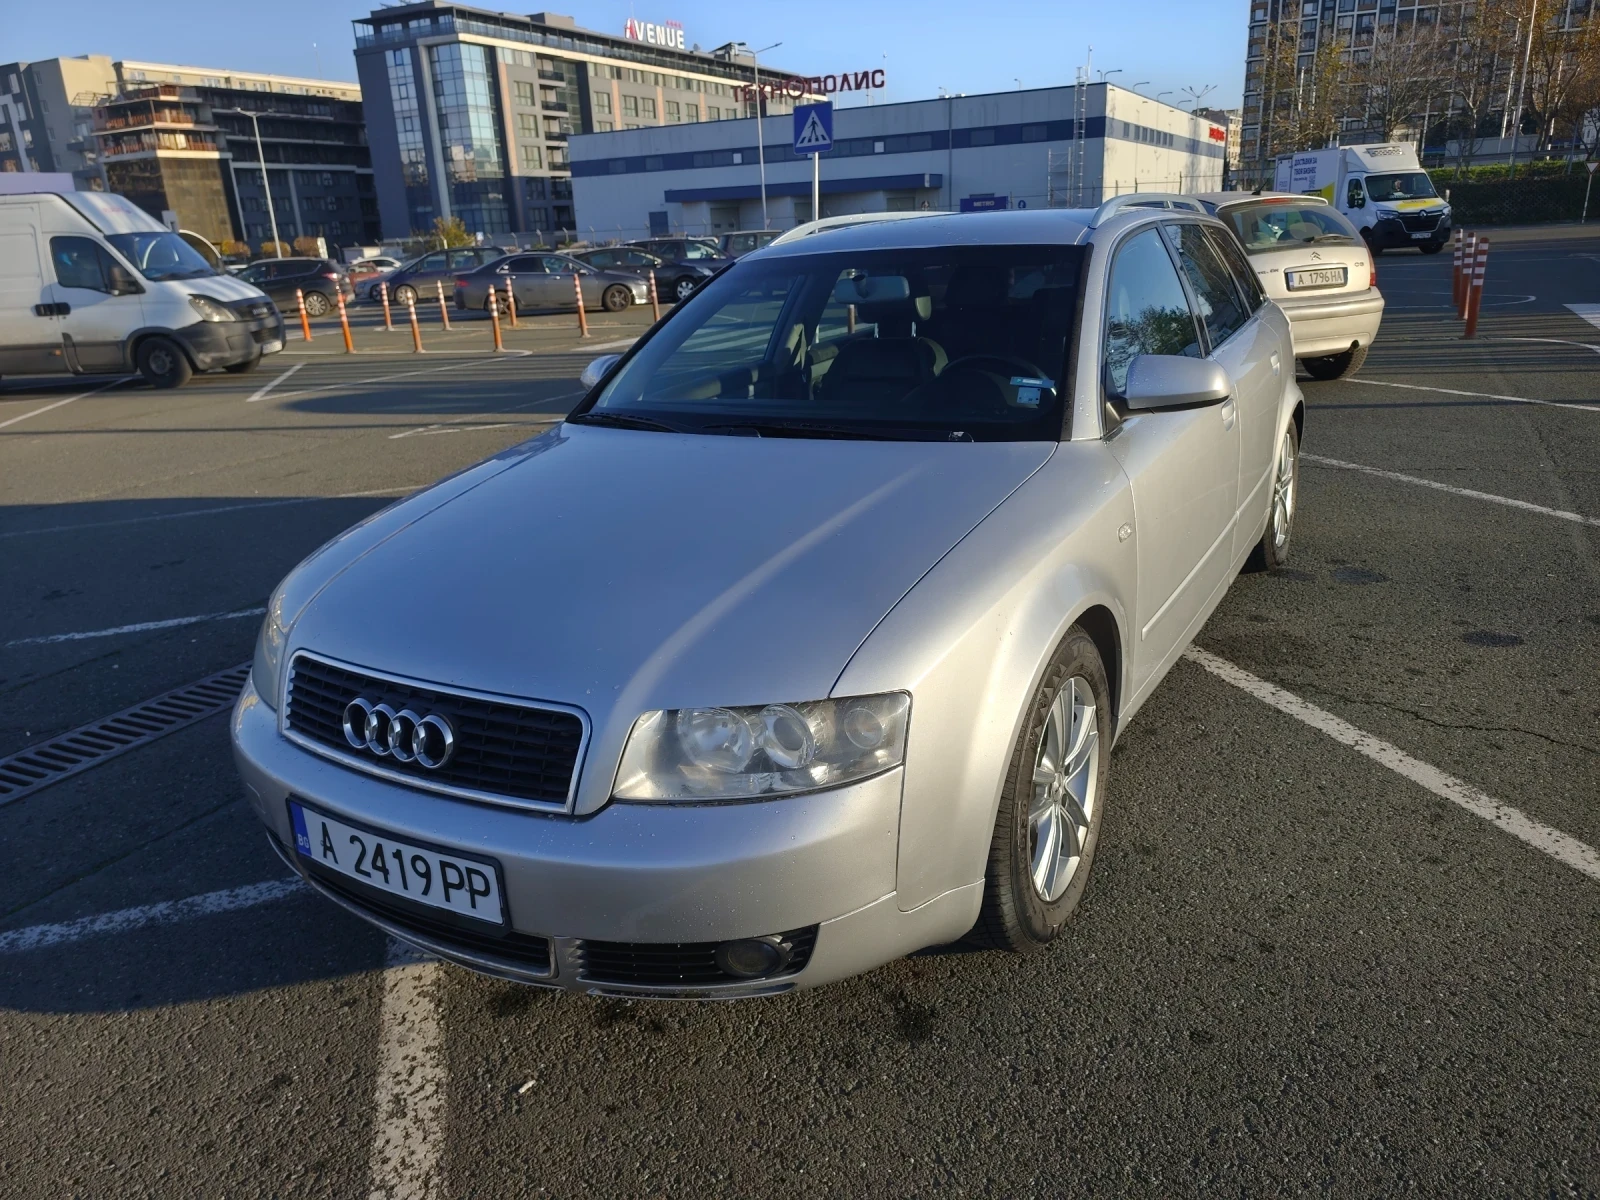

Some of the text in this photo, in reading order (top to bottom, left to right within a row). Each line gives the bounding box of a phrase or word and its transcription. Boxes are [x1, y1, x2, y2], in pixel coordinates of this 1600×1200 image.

[625, 18, 685, 49] AVENUE
[731, 69, 885, 102] ТЕХНОПОЛИС
[297, 833, 310, 849] BG
